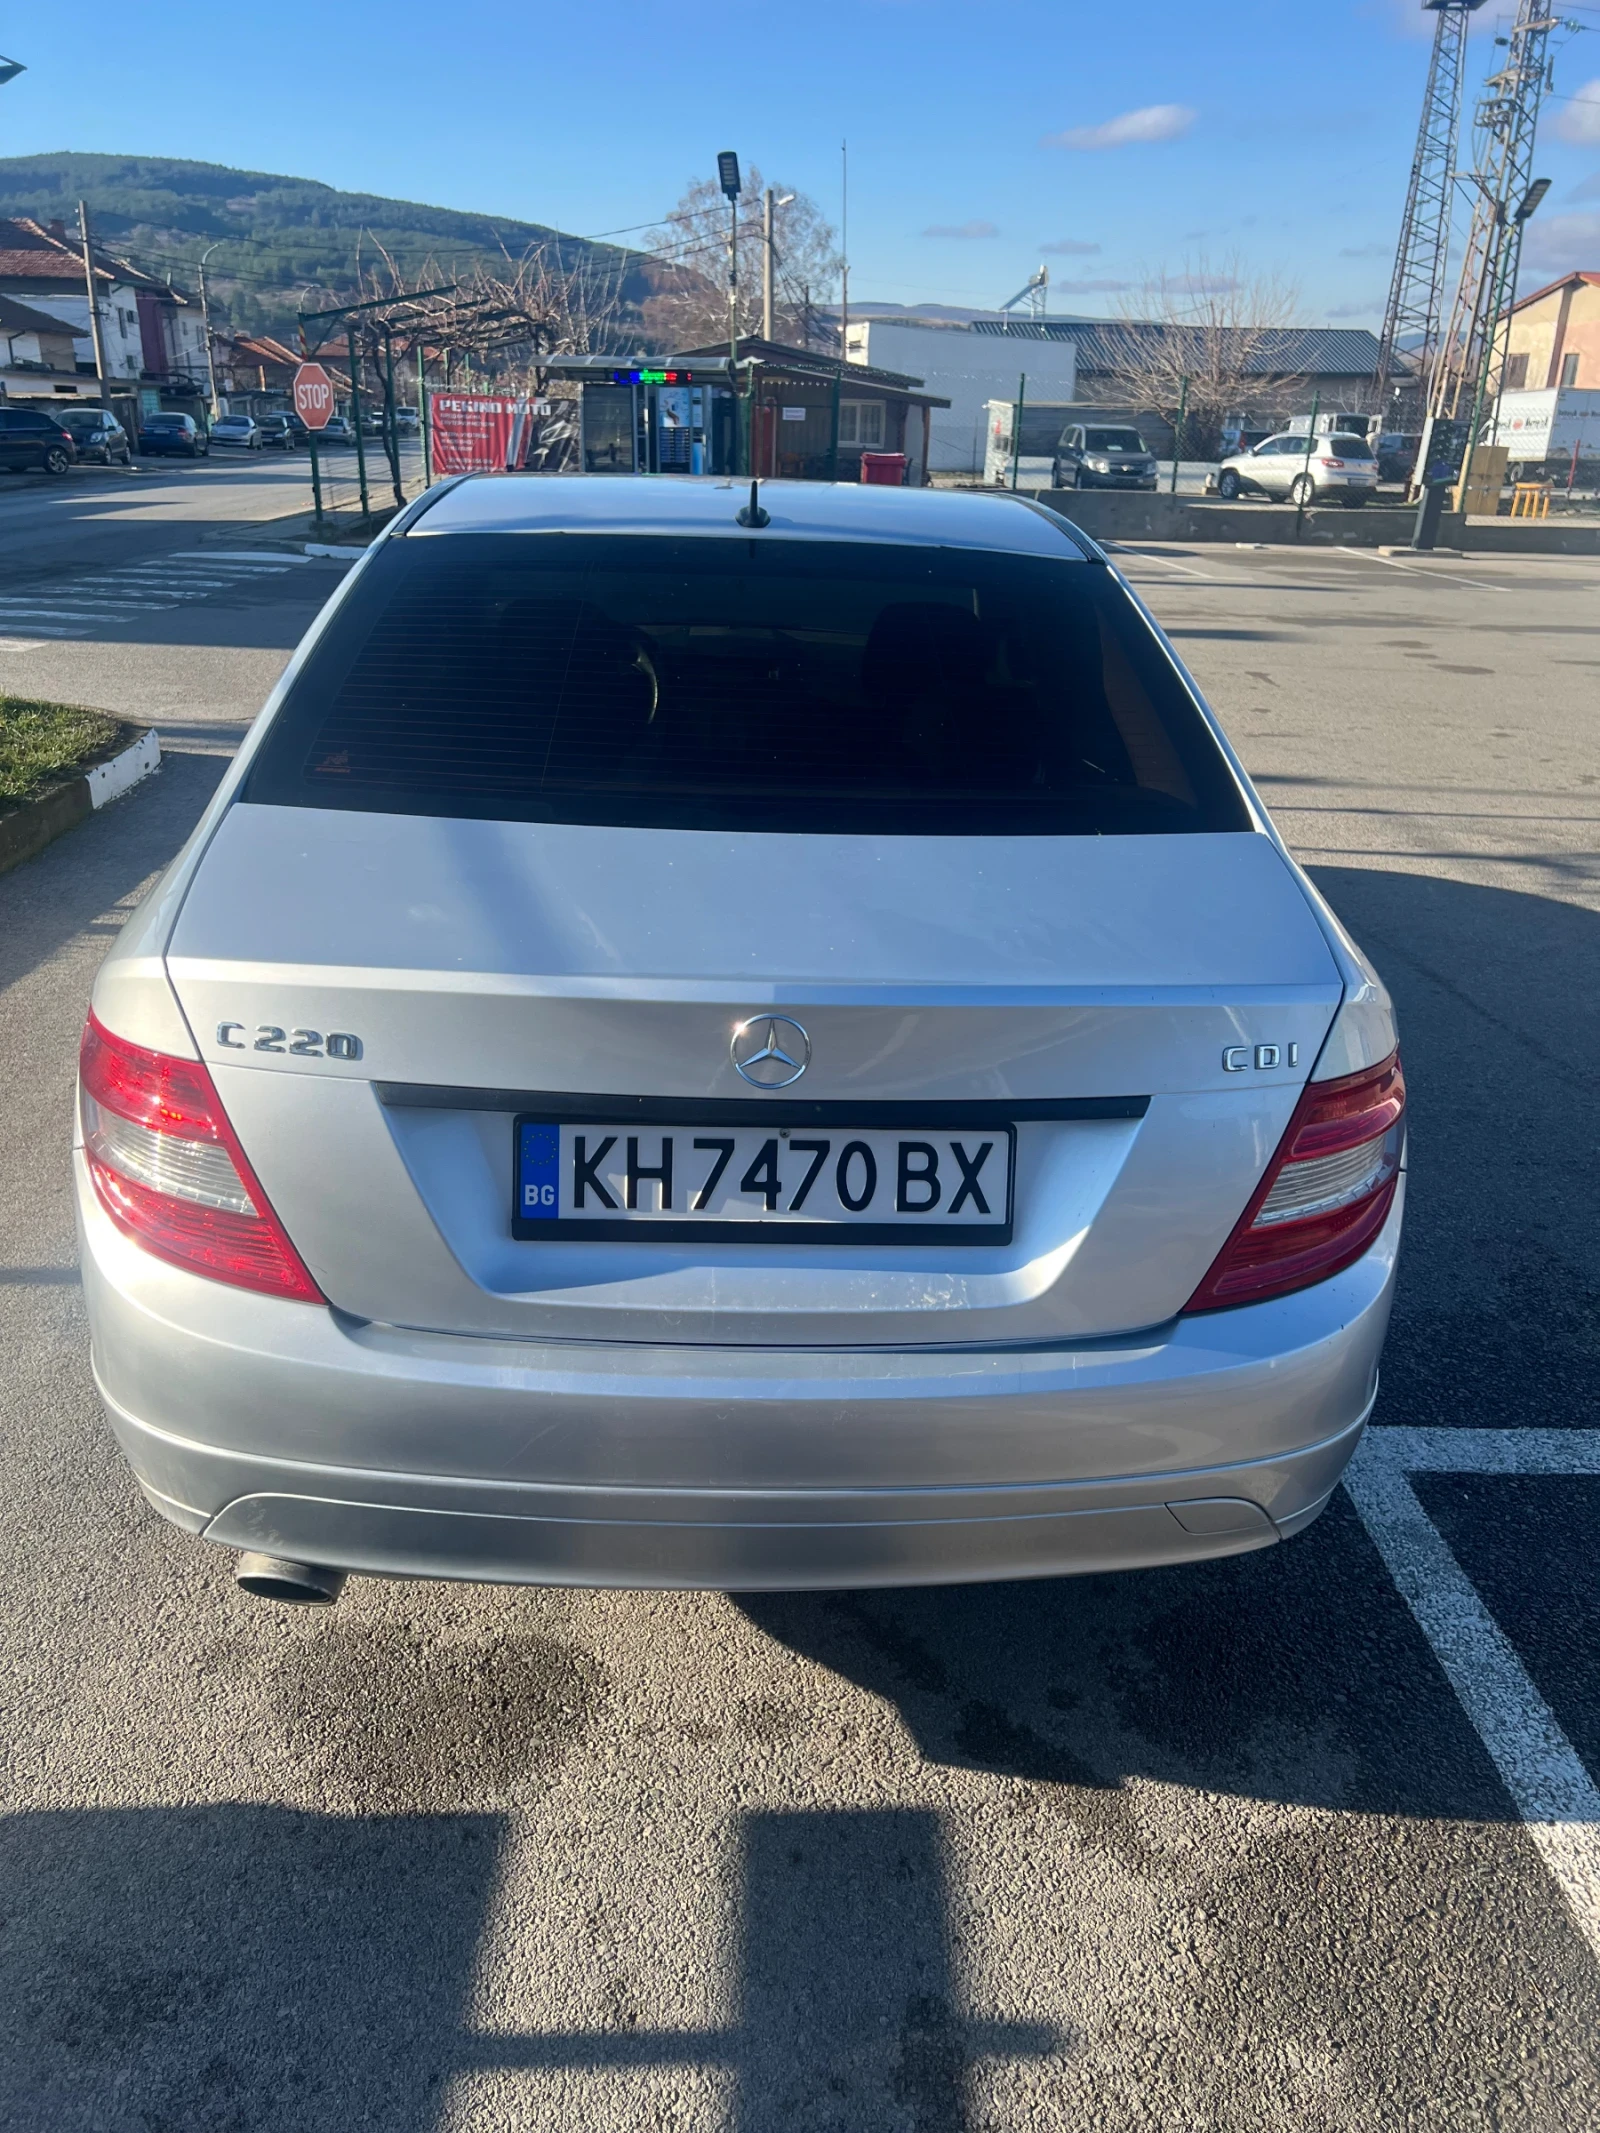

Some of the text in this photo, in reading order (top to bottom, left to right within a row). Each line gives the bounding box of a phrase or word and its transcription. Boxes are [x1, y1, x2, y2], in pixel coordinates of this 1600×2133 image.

[298, 383, 329, 410] STOP
[439, 399, 551, 416] PEKINO MOTO
[216, 1021, 364, 1061] C 220
[1222, 1042, 1298, 1072] CDI
[524, 1184, 555, 1207] BG
